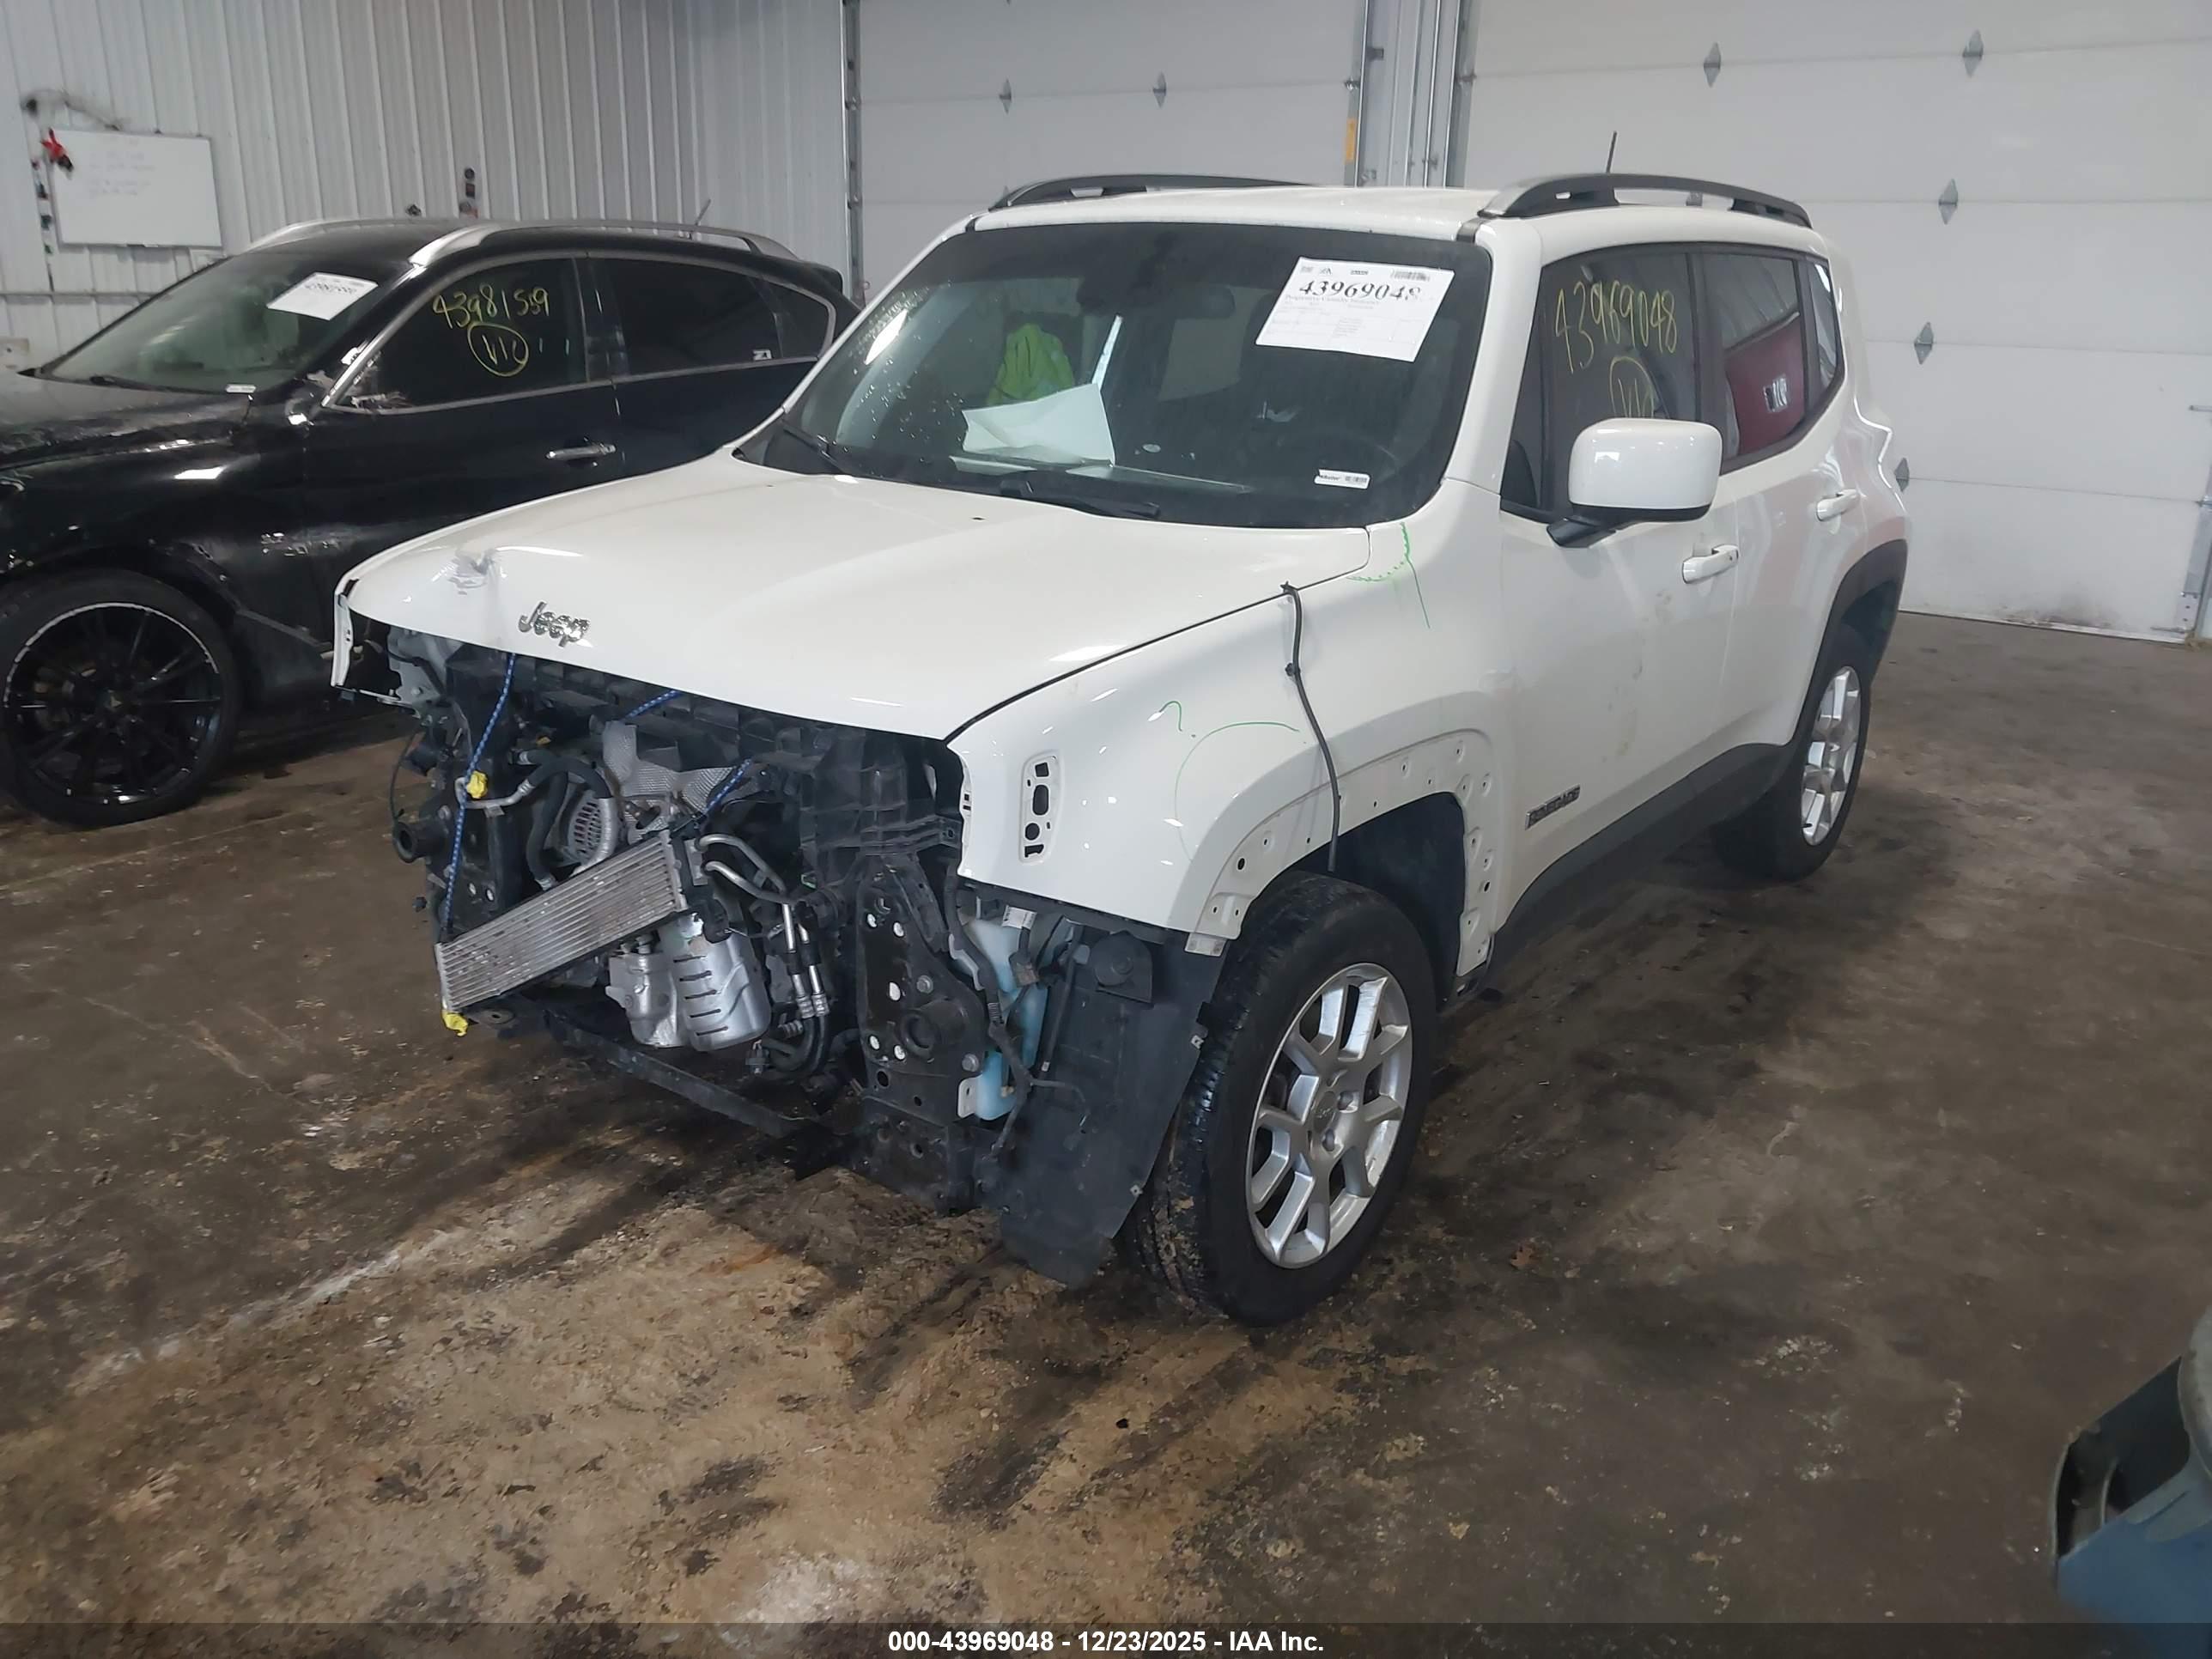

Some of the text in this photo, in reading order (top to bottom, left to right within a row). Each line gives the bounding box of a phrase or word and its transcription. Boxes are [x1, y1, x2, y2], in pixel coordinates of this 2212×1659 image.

[1298, 280, 1421, 301] 43969048
[1555, 280, 1677, 374] 43969048
[518, 600, 590, 647] Jeep
